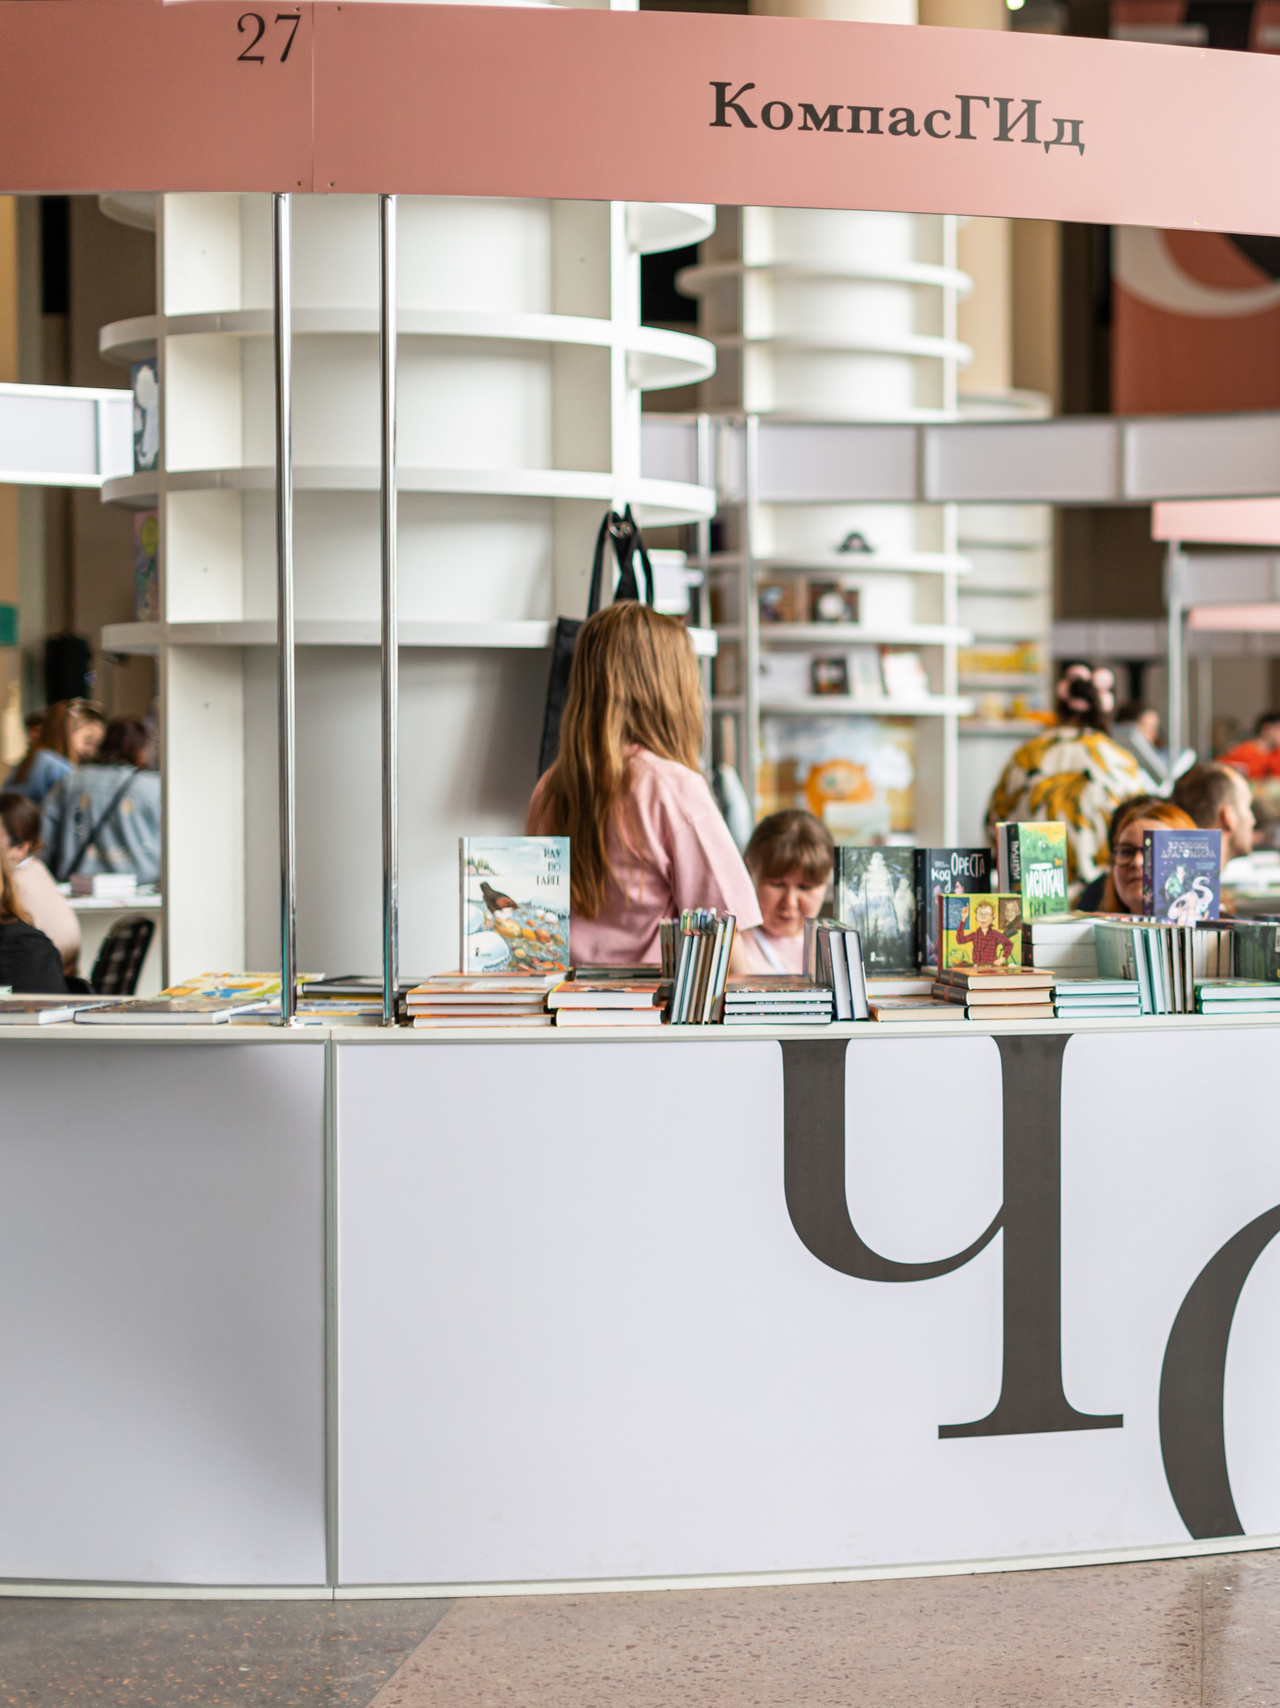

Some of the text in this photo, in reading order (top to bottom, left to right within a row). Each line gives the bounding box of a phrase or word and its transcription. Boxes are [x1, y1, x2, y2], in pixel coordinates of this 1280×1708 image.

[236, 12, 302, 66] 27
[708, 80, 1086, 157] КомпасГИд
[950, 852, 986, 878] ОРЕСТА
[1025, 862, 1065, 899] ИСТУКАН
